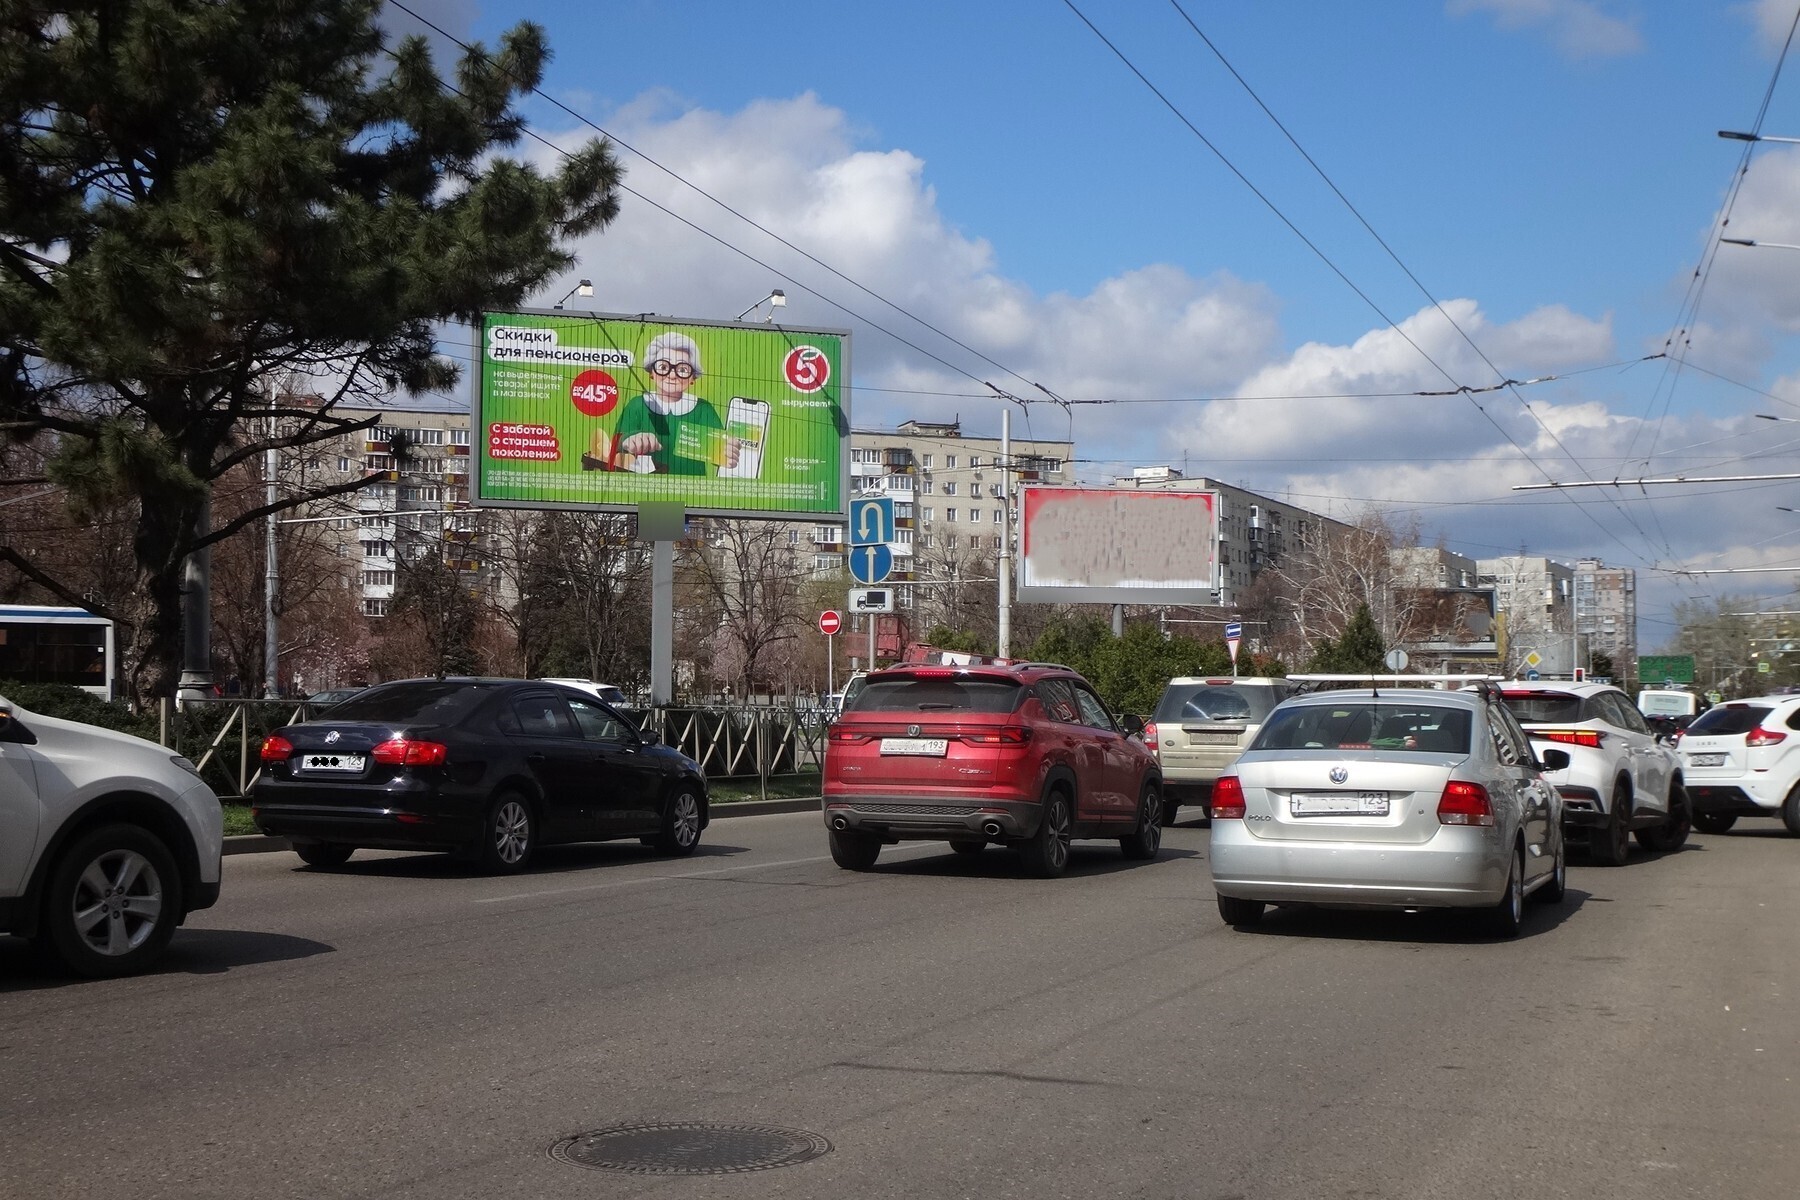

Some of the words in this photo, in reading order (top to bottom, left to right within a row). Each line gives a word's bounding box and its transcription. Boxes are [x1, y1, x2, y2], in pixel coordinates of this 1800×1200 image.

[495, 329, 552, 343] Скидки
[494, 347, 521, 358] для
[525, 349, 629, 365] пенсионеров
[507, 372, 563, 381] выделенные
[500, 390, 550, 399] магазинах
[492, 424, 501, 433] С
[502, 424, 551, 436] заботой
[492, 437, 499, 445] о
[502, 437, 556, 448] старшем
[492, 448, 558, 459] поколении
[928, 741, 944, 749] 193
[347, 756, 363, 767] 123
[1360, 793, 1383, 805] 123
